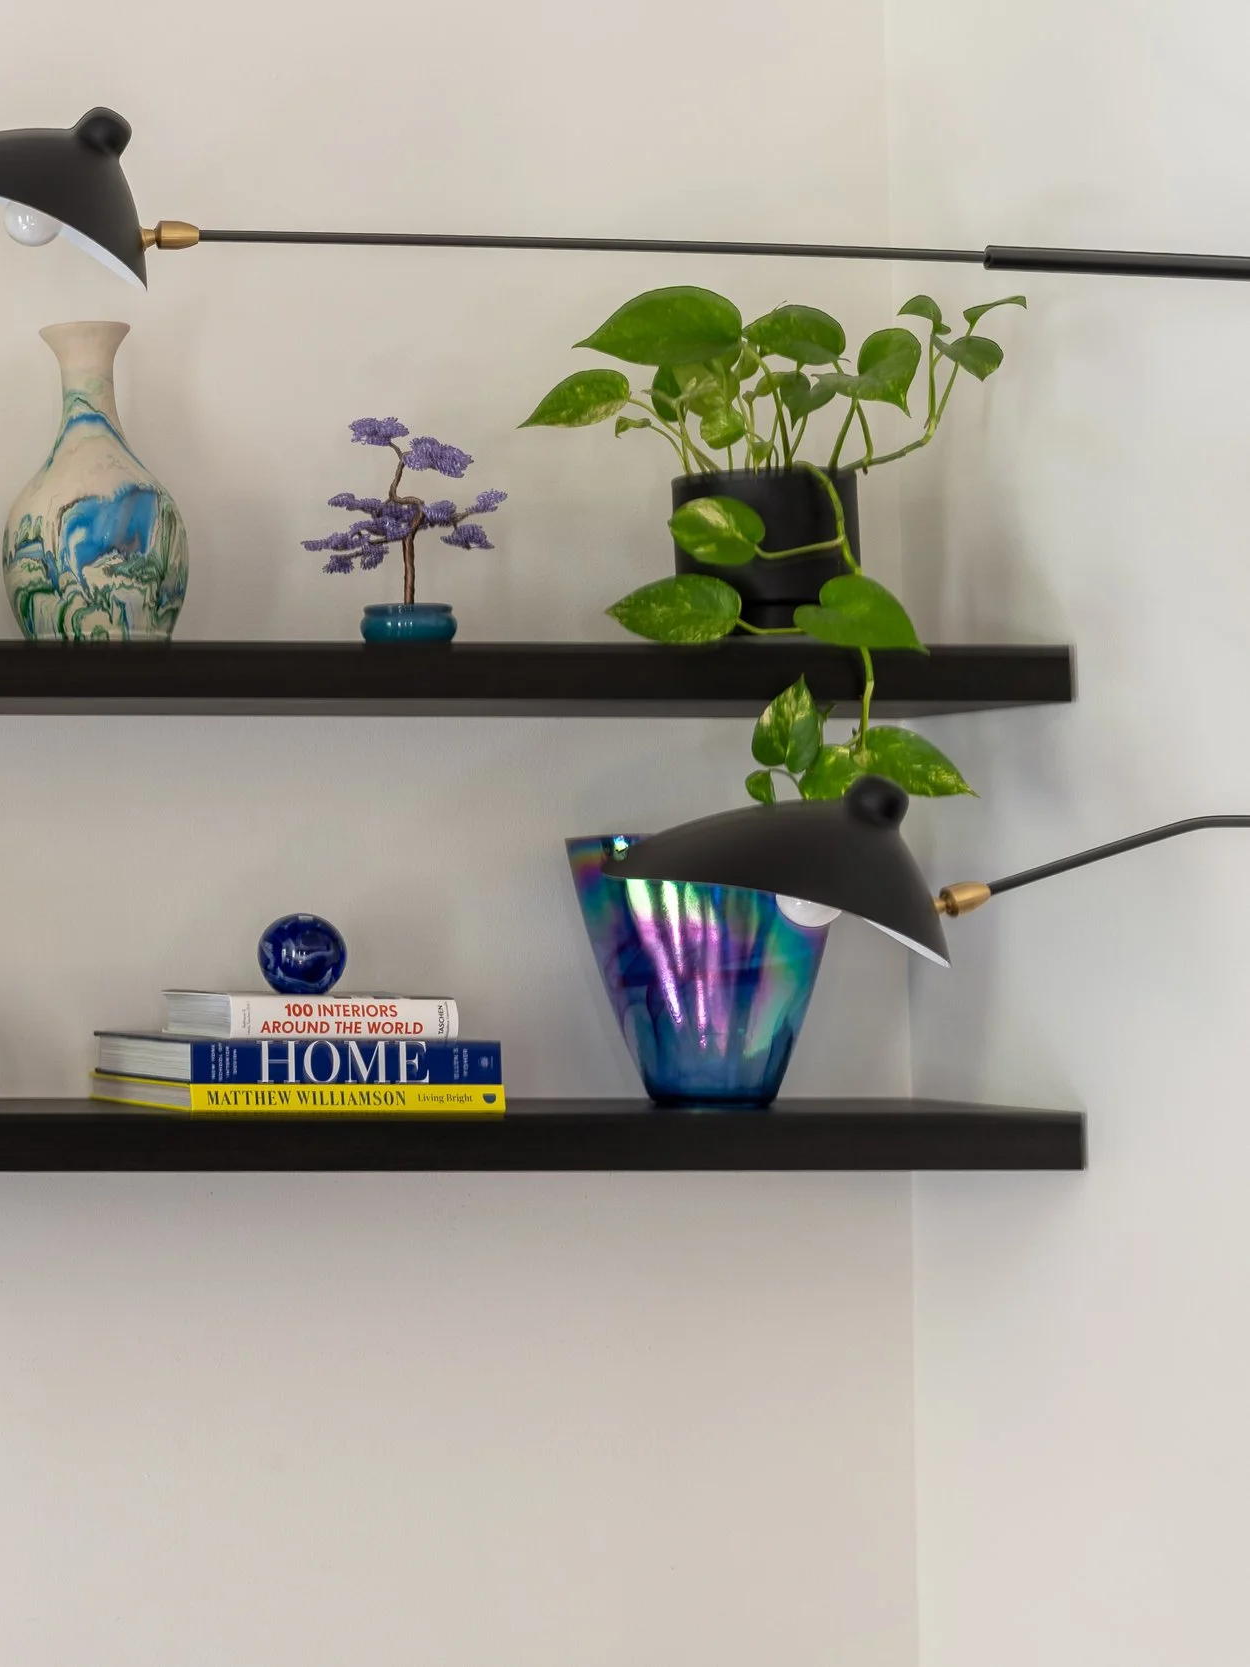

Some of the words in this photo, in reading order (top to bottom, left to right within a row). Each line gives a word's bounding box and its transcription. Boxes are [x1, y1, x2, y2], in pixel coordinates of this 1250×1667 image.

[285, 1003, 313, 1017] 100
[317, 1004, 398, 1017] INTERIORS
[260, 1020, 330, 1034] AROUND
[334, 1021, 362, 1034] THE
[367, 1021, 424, 1035] WORLD
[256, 1040, 430, 1084] HOME
[207, 1090, 292, 1106] MATTHEW
[296, 1091, 406, 1106] WILLIAMSON
[417, 1093, 444, 1104] Living
[446, 1093, 473, 1104] Bright
